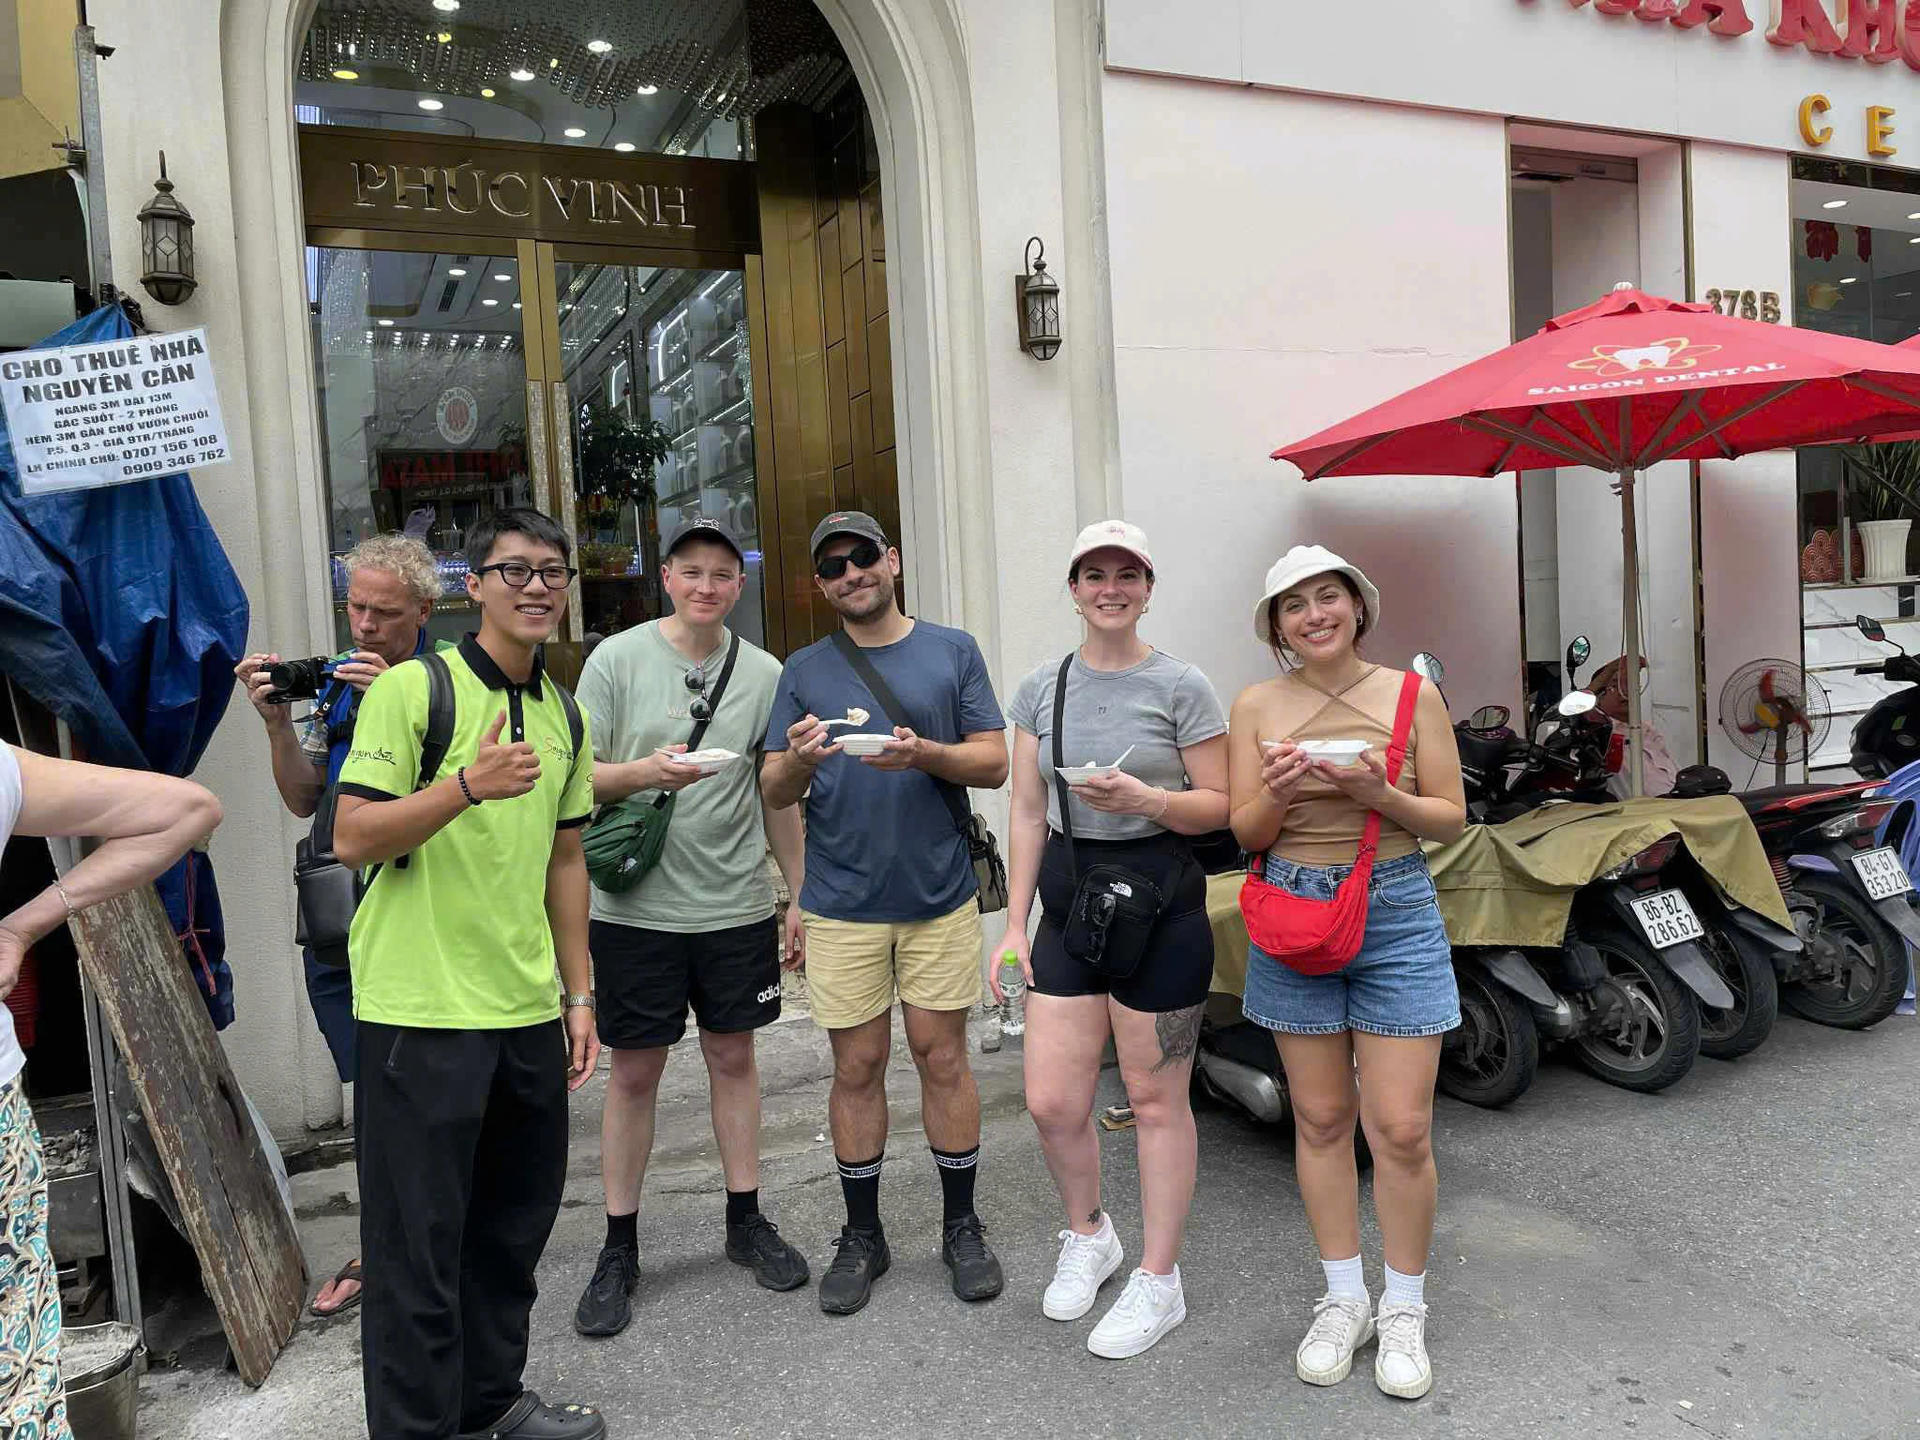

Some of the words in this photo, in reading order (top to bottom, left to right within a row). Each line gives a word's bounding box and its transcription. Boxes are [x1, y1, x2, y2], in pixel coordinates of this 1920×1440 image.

[350, 159, 532, 217] PHÚC
[541, 175, 697, 229] VINH
[1706, 288, 1781, 324] 378B
[2, 357, 63, 381] CHO
[70, 345, 143, 373] THUÊ
[1527, 379, 1644, 395] SAIGON
[1654, 362, 1786, 383] DENTAL
[22, 373, 133, 403] NGUYÊN
[141, 363, 195, 388] CĂN
[55, 403, 97, 416] NGANG
[100, 400, 120, 410] 3M
[149, 392, 172, 403] 13M
[127, 410, 135, 419] 2
[56, 432, 76, 442] 3M
[122, 446, 157, 460] 0707
[161, 440, 188, 453] 156
[192, 434, 218, 447] 108
[122, 460, 163, 475] 0909
[167, 454, 196, 467] 346
[200, 448, 226, 461] 762
[1648, 913, 1699, 944] 286.62
